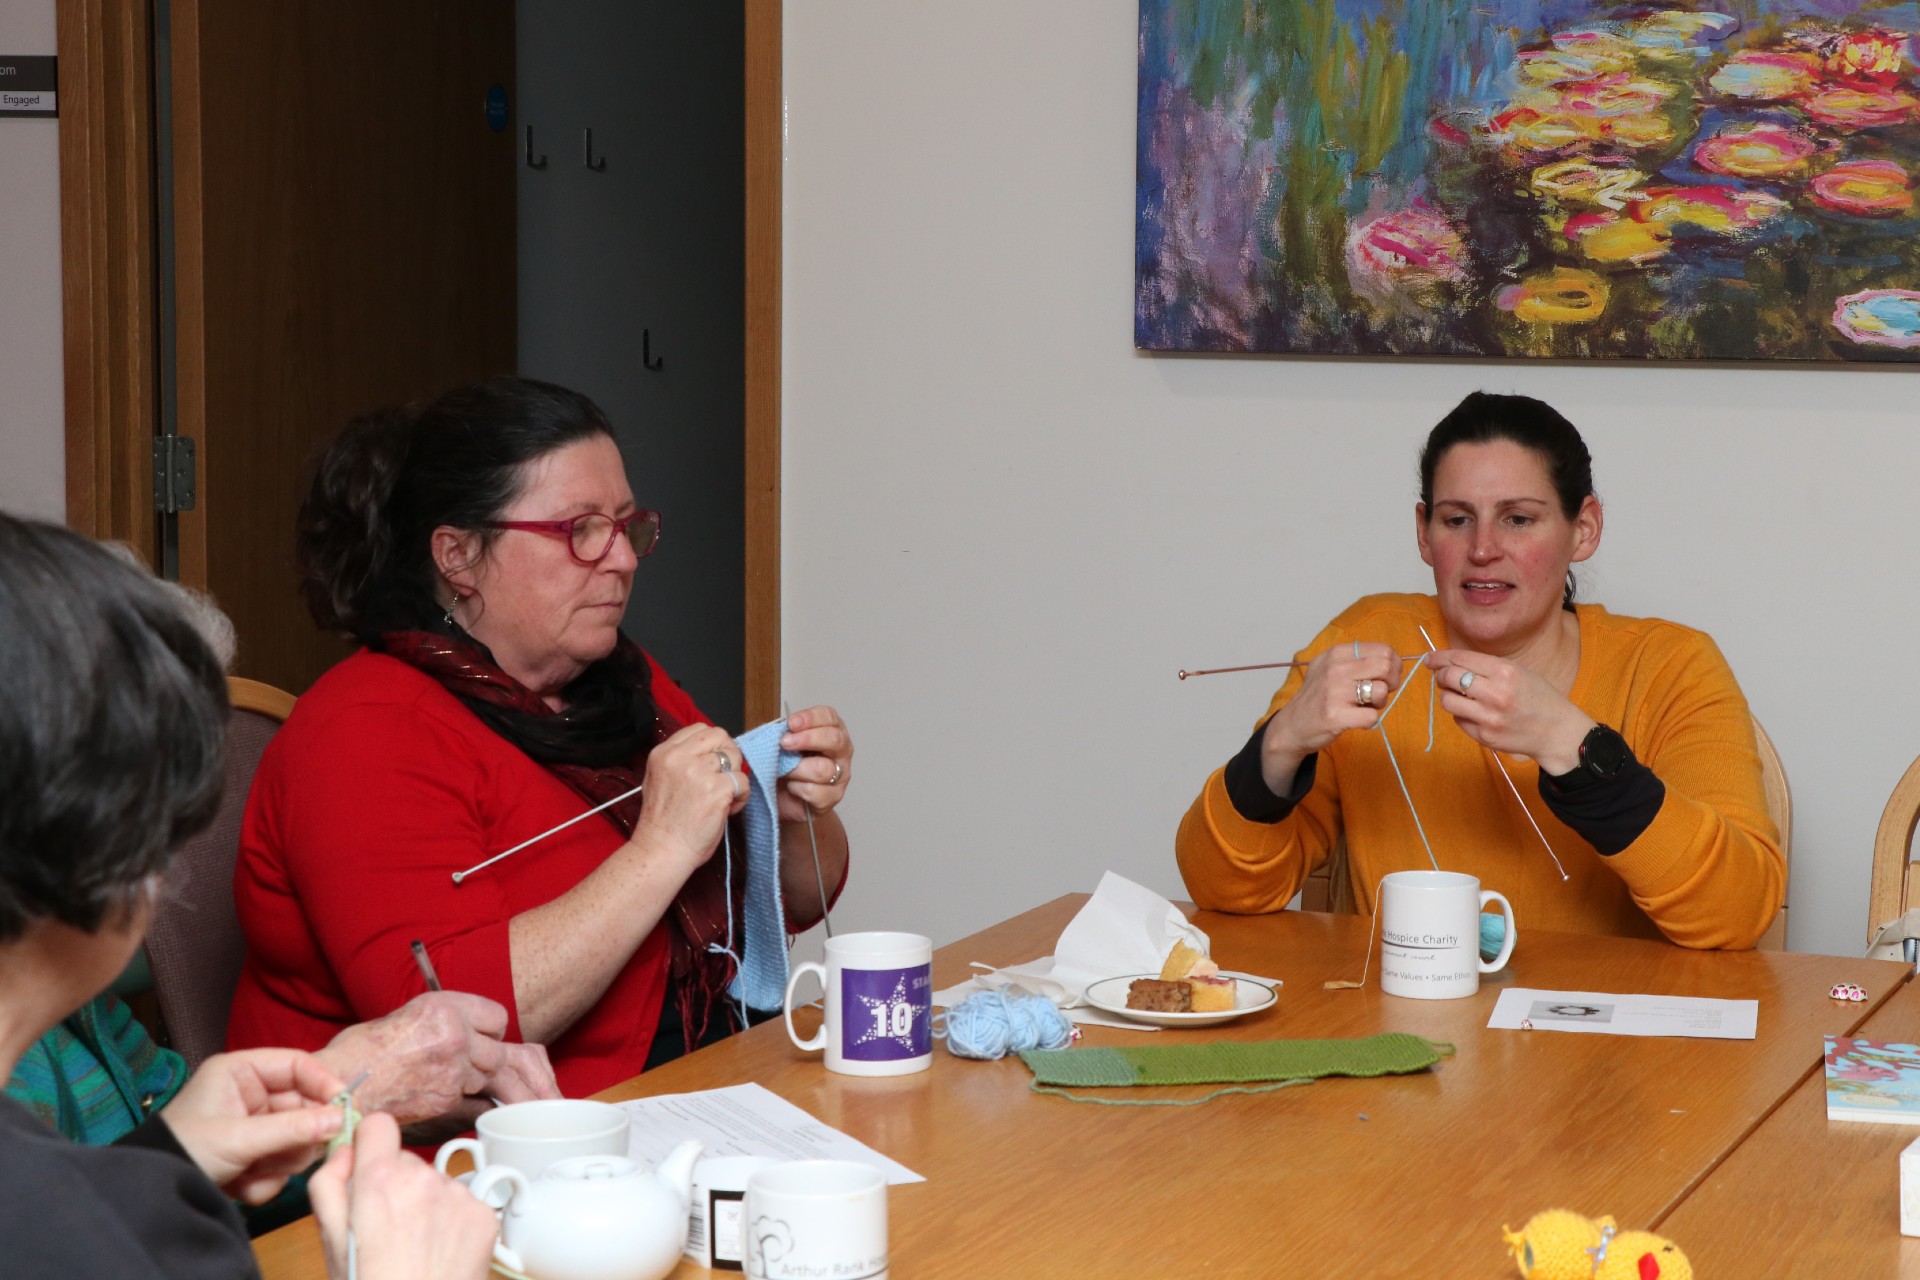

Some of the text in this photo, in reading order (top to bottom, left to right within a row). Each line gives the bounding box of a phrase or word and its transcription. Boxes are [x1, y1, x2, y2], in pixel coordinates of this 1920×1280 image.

[3, 94, 40, 107] Engaged
[1387, 930, 1419, 944] Hospice
[1422, 934, 1458, 946] Charity
[1400, 972, 1423, 981] Values
[1431, 974, 1453, 982] Same
[870, 1002, 913, 1038] 10
[780, 1264, 828, 1277] Arthur
[833, 1261, 864, 1276] Rank
